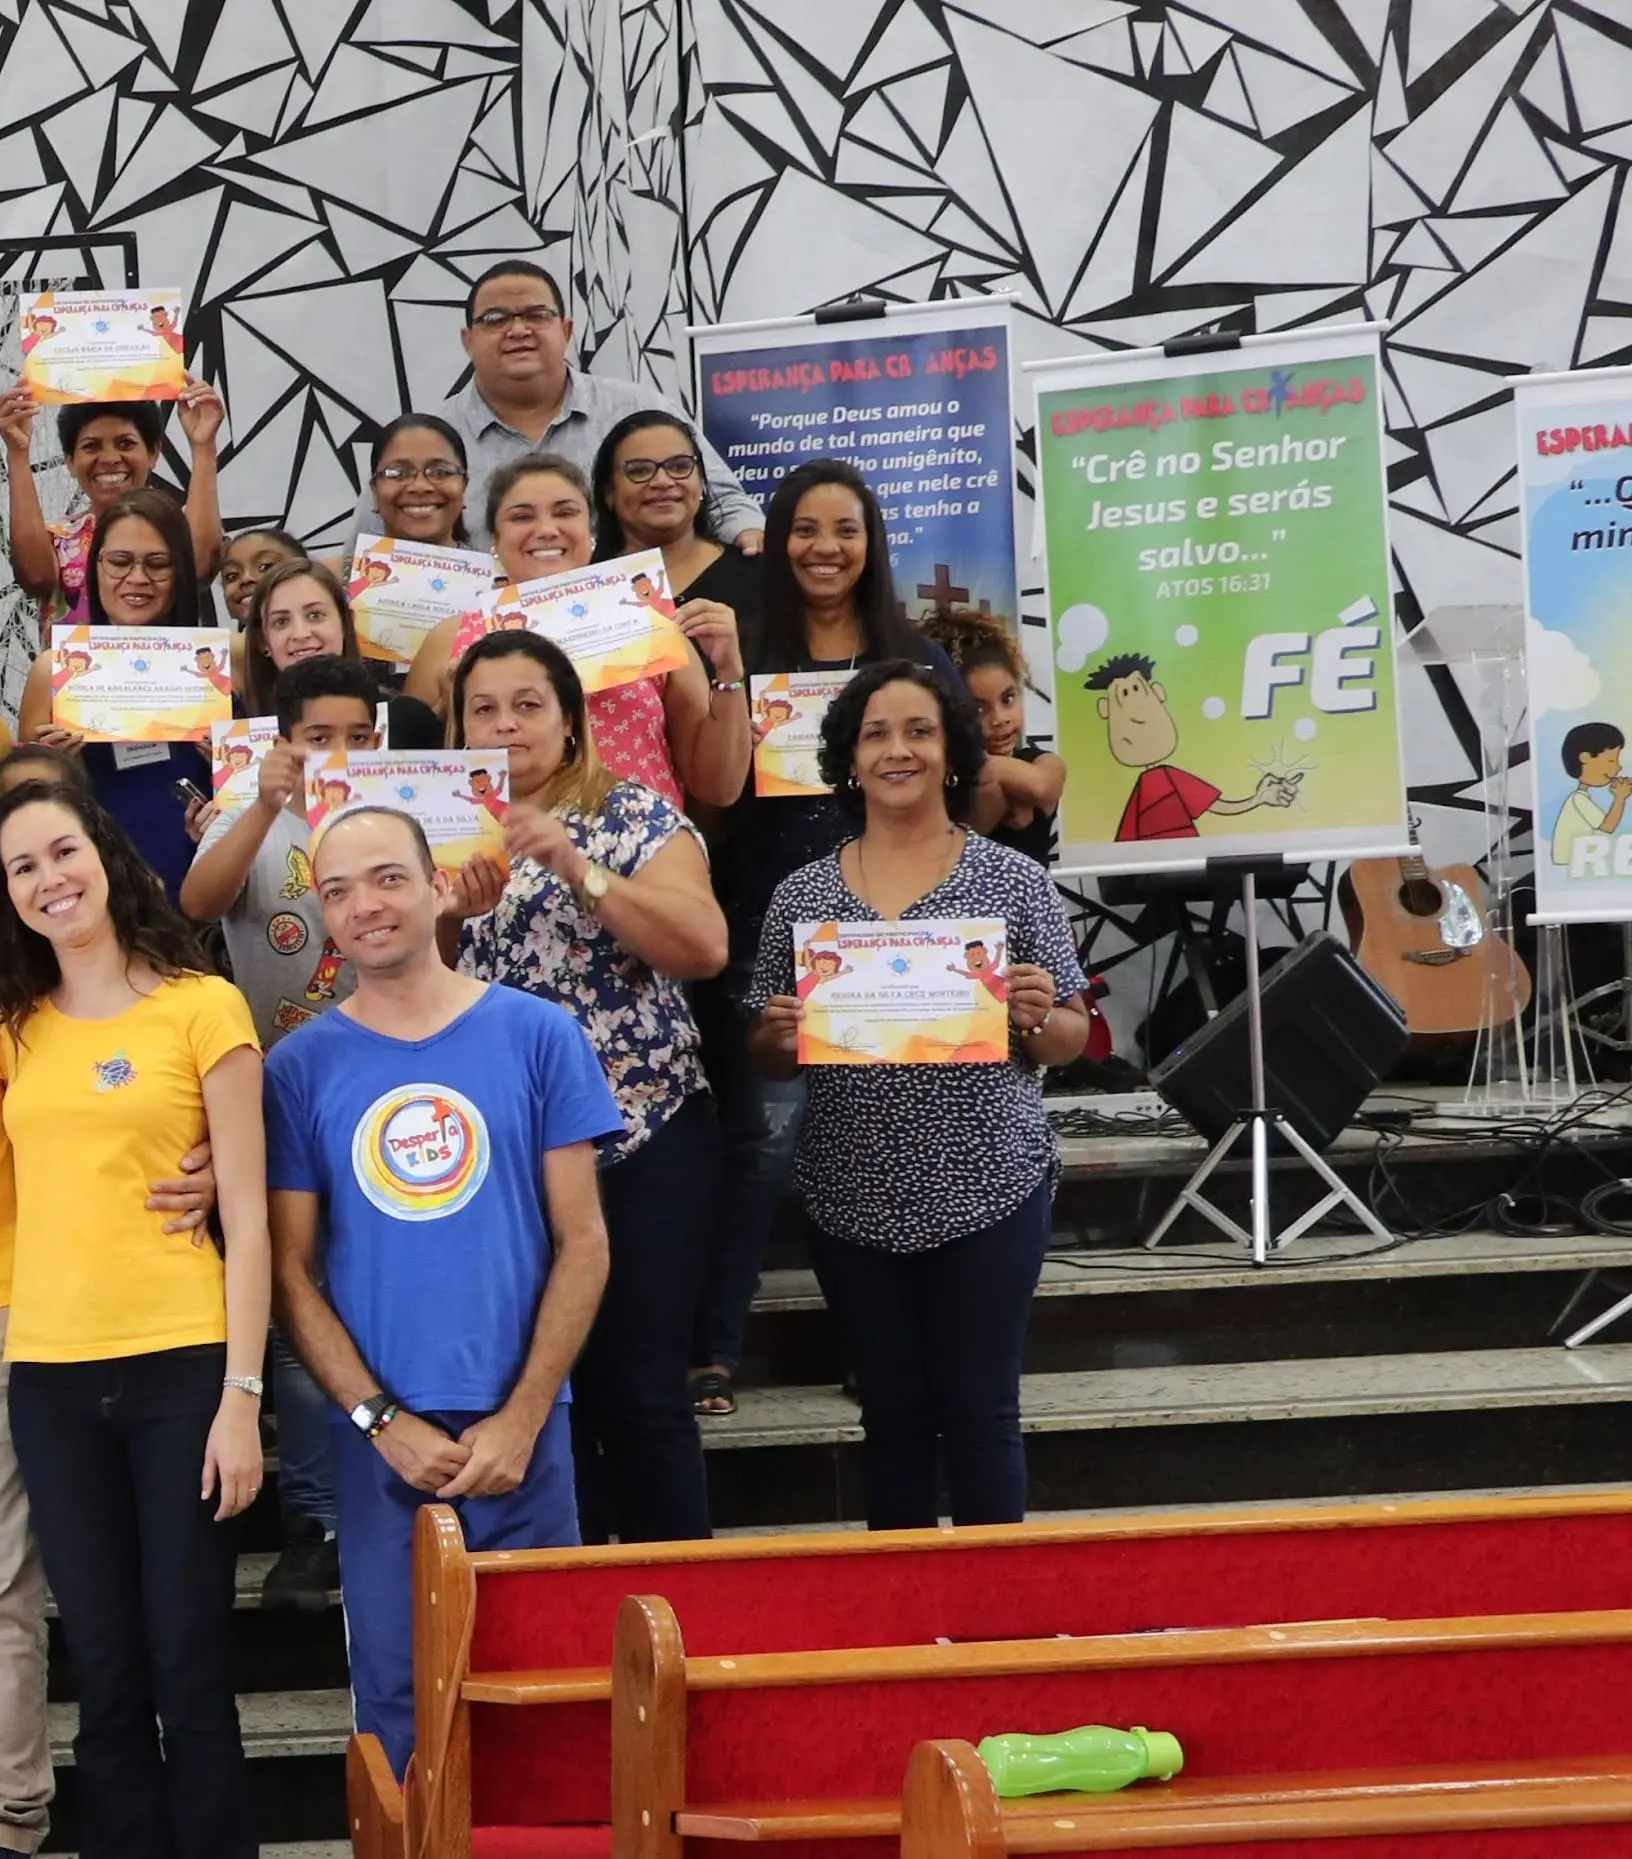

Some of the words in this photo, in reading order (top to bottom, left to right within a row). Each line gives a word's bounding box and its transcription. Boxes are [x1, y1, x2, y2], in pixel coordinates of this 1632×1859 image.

[712, 363, 825, 395] ESPERANÇA
[831, 359, 881, 383] PARA
[833, 406, 882, 424] Deus
[887, 402, 943, 420] amou
[947, 400, 960, 414] o
[1052, 403, 1177, 437] ESPERANÇA
[1181, 393, 1236, 420] PARA
[728, 437, 794, 459] mundo
[800, 433, 823, 452] de
[829, 429, 856, 450] tal
[860, 425, 942, 449] maneira
[948, 421, 986, 446] que
[1156, 453, 1201, 478] no
[1211, 434, 1347, 472] Senhor
[735, 461, 768, 482] deu
[773, 464, 785, 480] o
[882, 449, 983, 473] unigênito,
[877, 480, 913, 500] que
[918, 476, 961, 494] nele
[966, 471, 998, 489] crê
[904, 500, 963, 519] tenha
[968, 498, 980, 515] a
[1086, 498, 1187, 531] Jesus
[1196, 496, 1218, 519] e
[1228, 479, 1333, 517] serás
[1156, 577, 1213, 599] ATOS
[1220, 572, 1272, 594] 16:31
[1241, 595, 1381, 721] FÉ
[405, 1145, 452, 1168] KIDS
